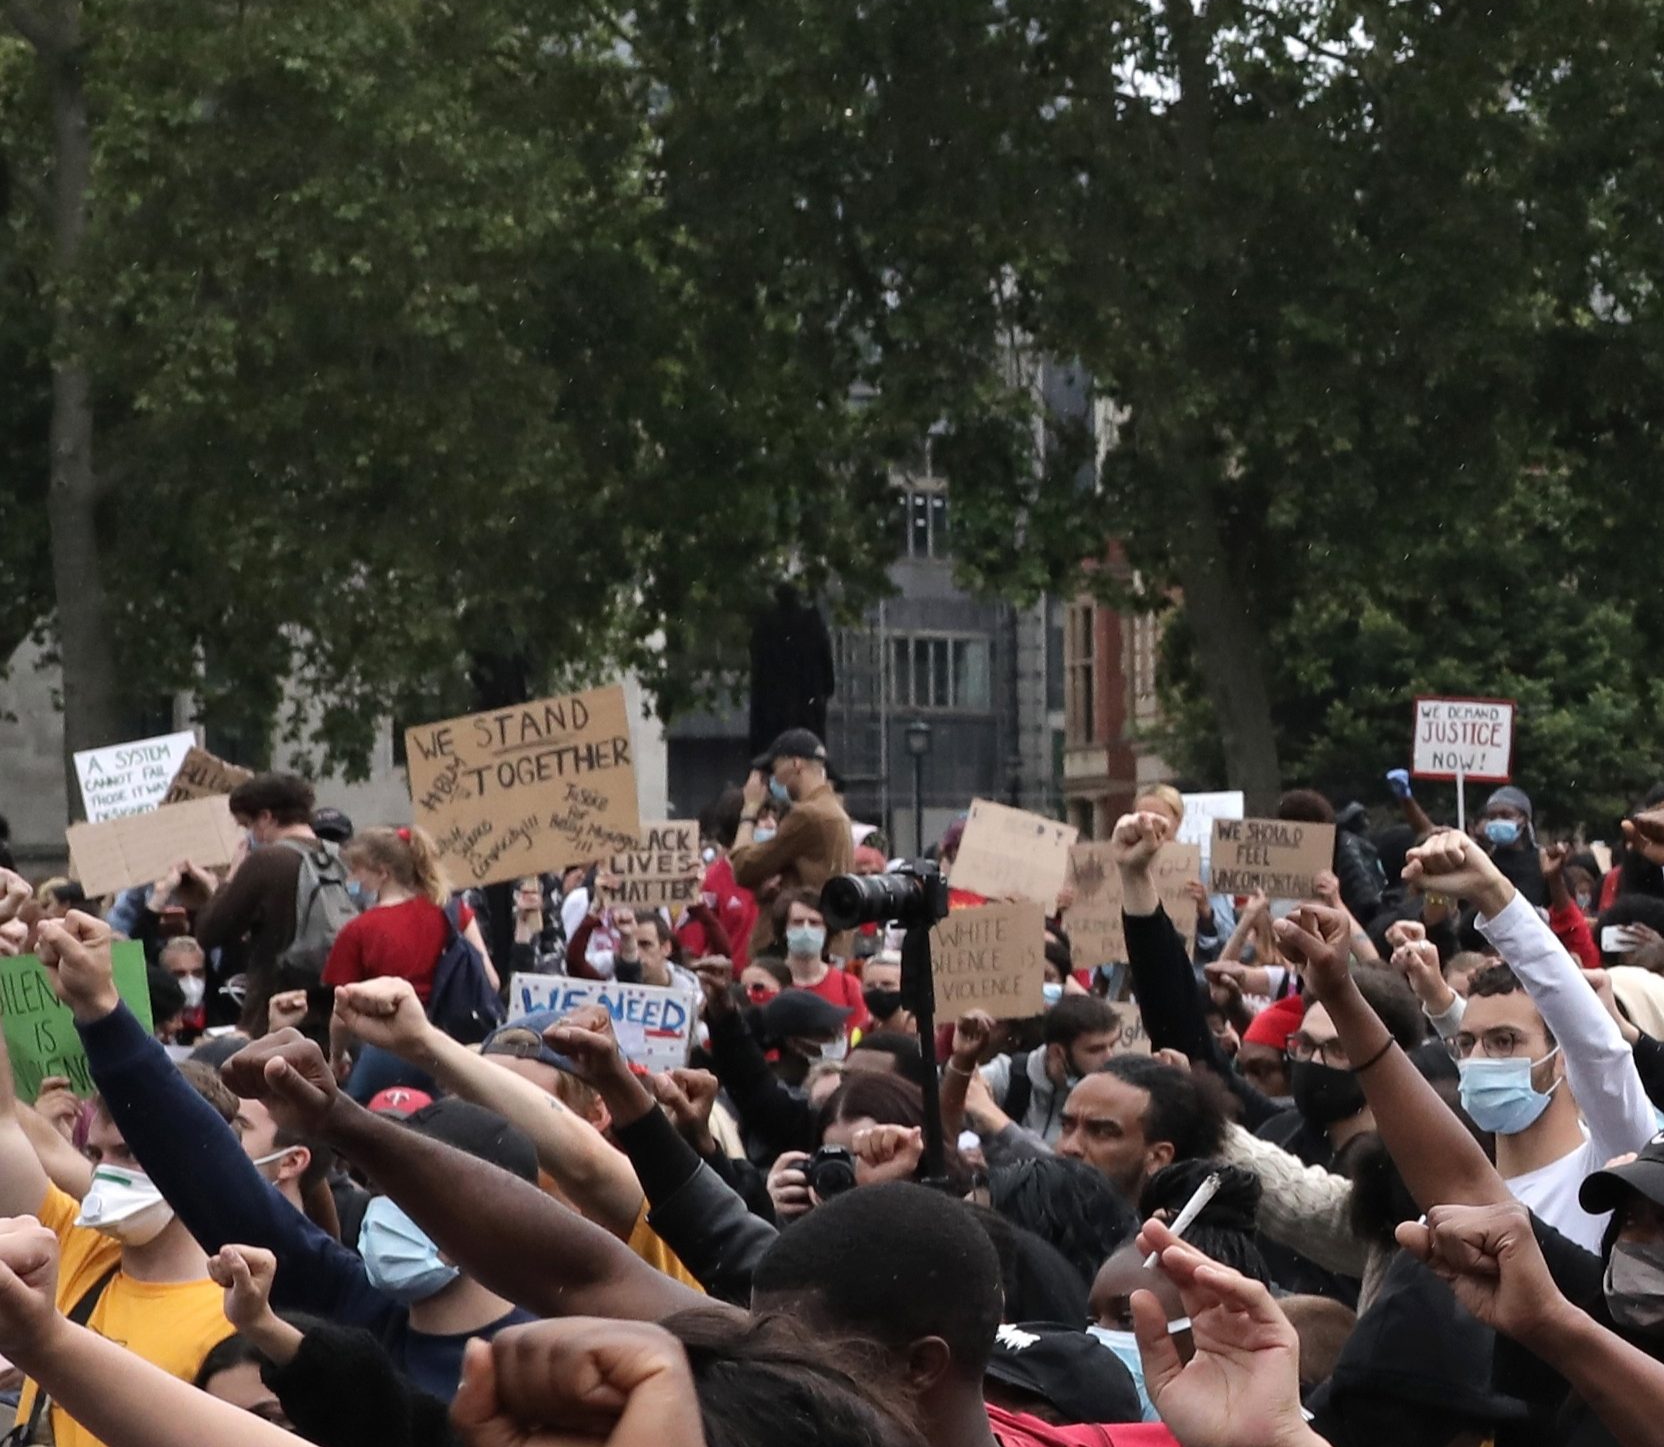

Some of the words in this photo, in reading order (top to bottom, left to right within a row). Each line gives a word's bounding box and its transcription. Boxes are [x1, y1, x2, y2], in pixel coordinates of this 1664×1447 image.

[1421, 704, 1439, 718] WE
[1448, 706, 1499, 720] DEMAND
[414, 728, 454, 760] WE
[475, 698, 589, 748] STAND
[1422, 721, 1503, 748] JUSTICE
[87, 755, 104, 774] A
[115, 744, 172, 770] SYSTEM
[463, 738, 632, 796] TOGETHER
[1433, 752, 1486, 770] NOW!
[84, 774, 133, 792] CANNOT
[143, 766, 166, 780] FAIL
[637, 828, 690, 851] ACK
[1217, 823, 1242, 841] WE
[1247, 825, 1303, 847] SHOULD
[610, 855, 693, 874] LIVES
[1236, 846, 1270, 866] FEEL
[608, 880, 696, 902] MATTER
[938, 917, 1009, 948] WHITE
[1021, 947, 1035, 966] IS
[0, 969, 60, 1016] ILEN
[943, 977, 1021, 1001] VIOLENCE
[34, 1019, 57, 1054] IS
